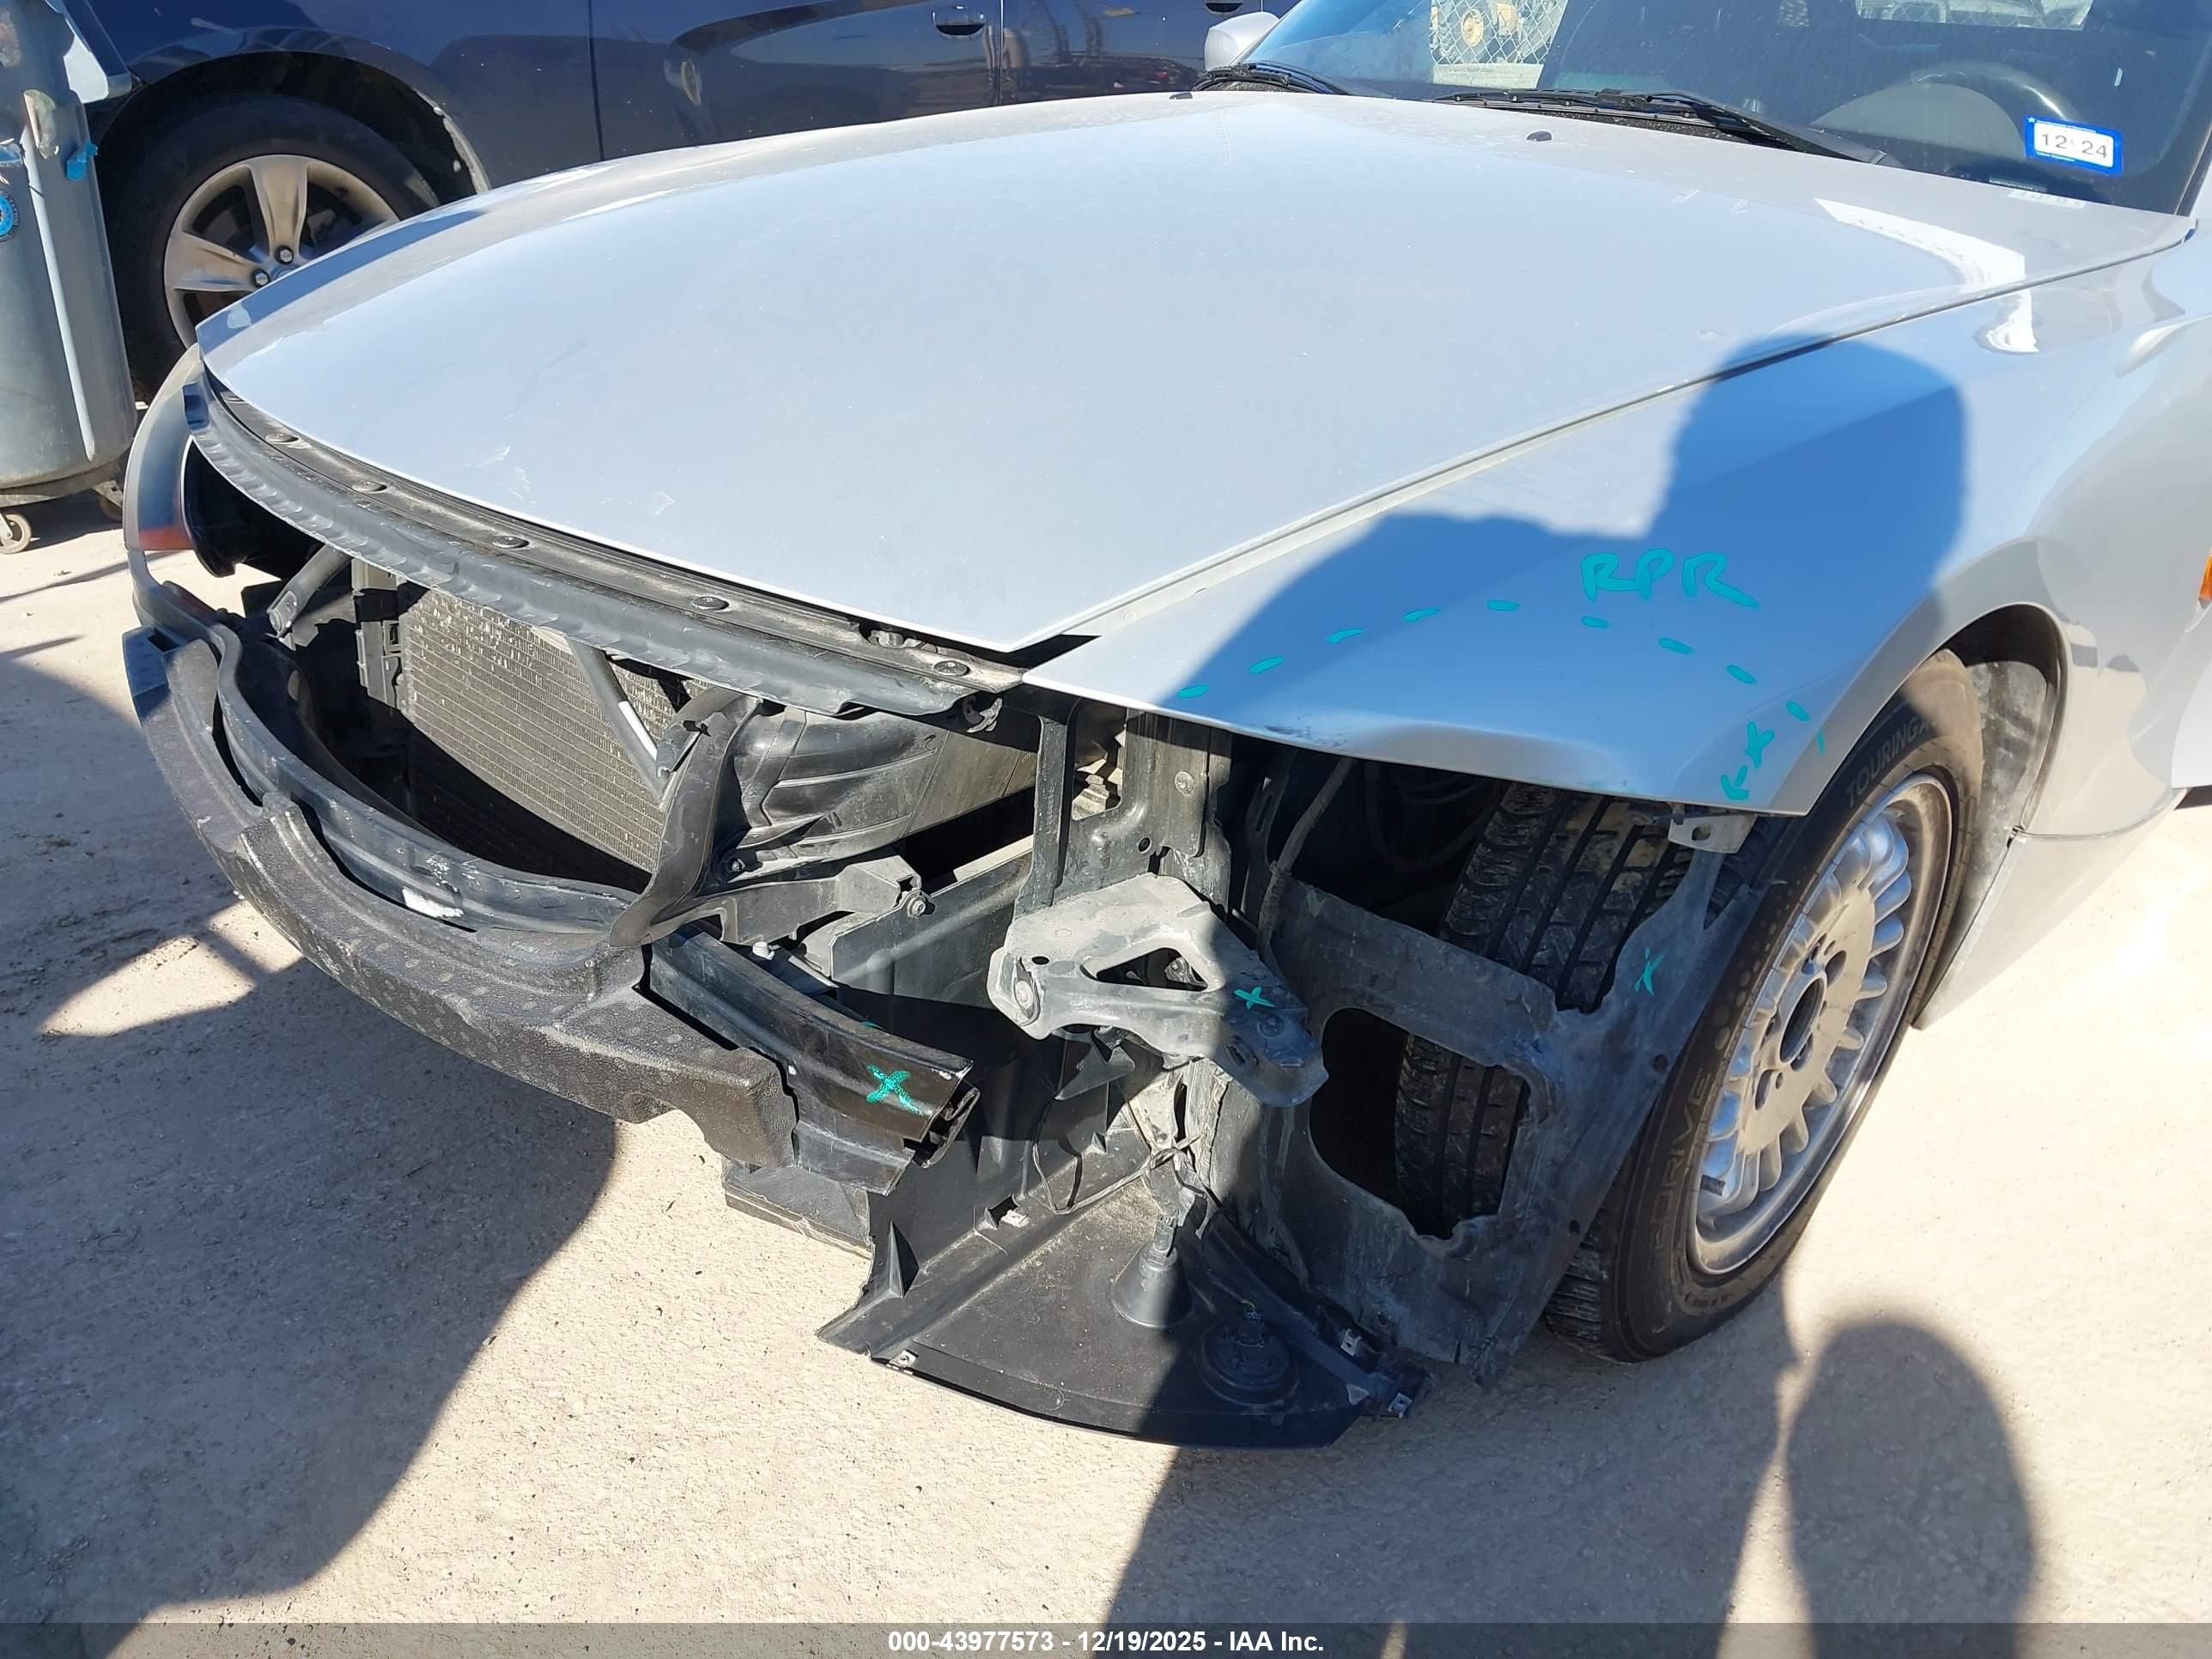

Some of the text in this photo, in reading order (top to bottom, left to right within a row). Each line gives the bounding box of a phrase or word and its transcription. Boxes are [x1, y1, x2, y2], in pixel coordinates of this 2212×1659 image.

[2040, 133, 2068, 149] 12
[2081, 140, 2108, 159] 24
[1580, 548, 1759, 607] RPR
